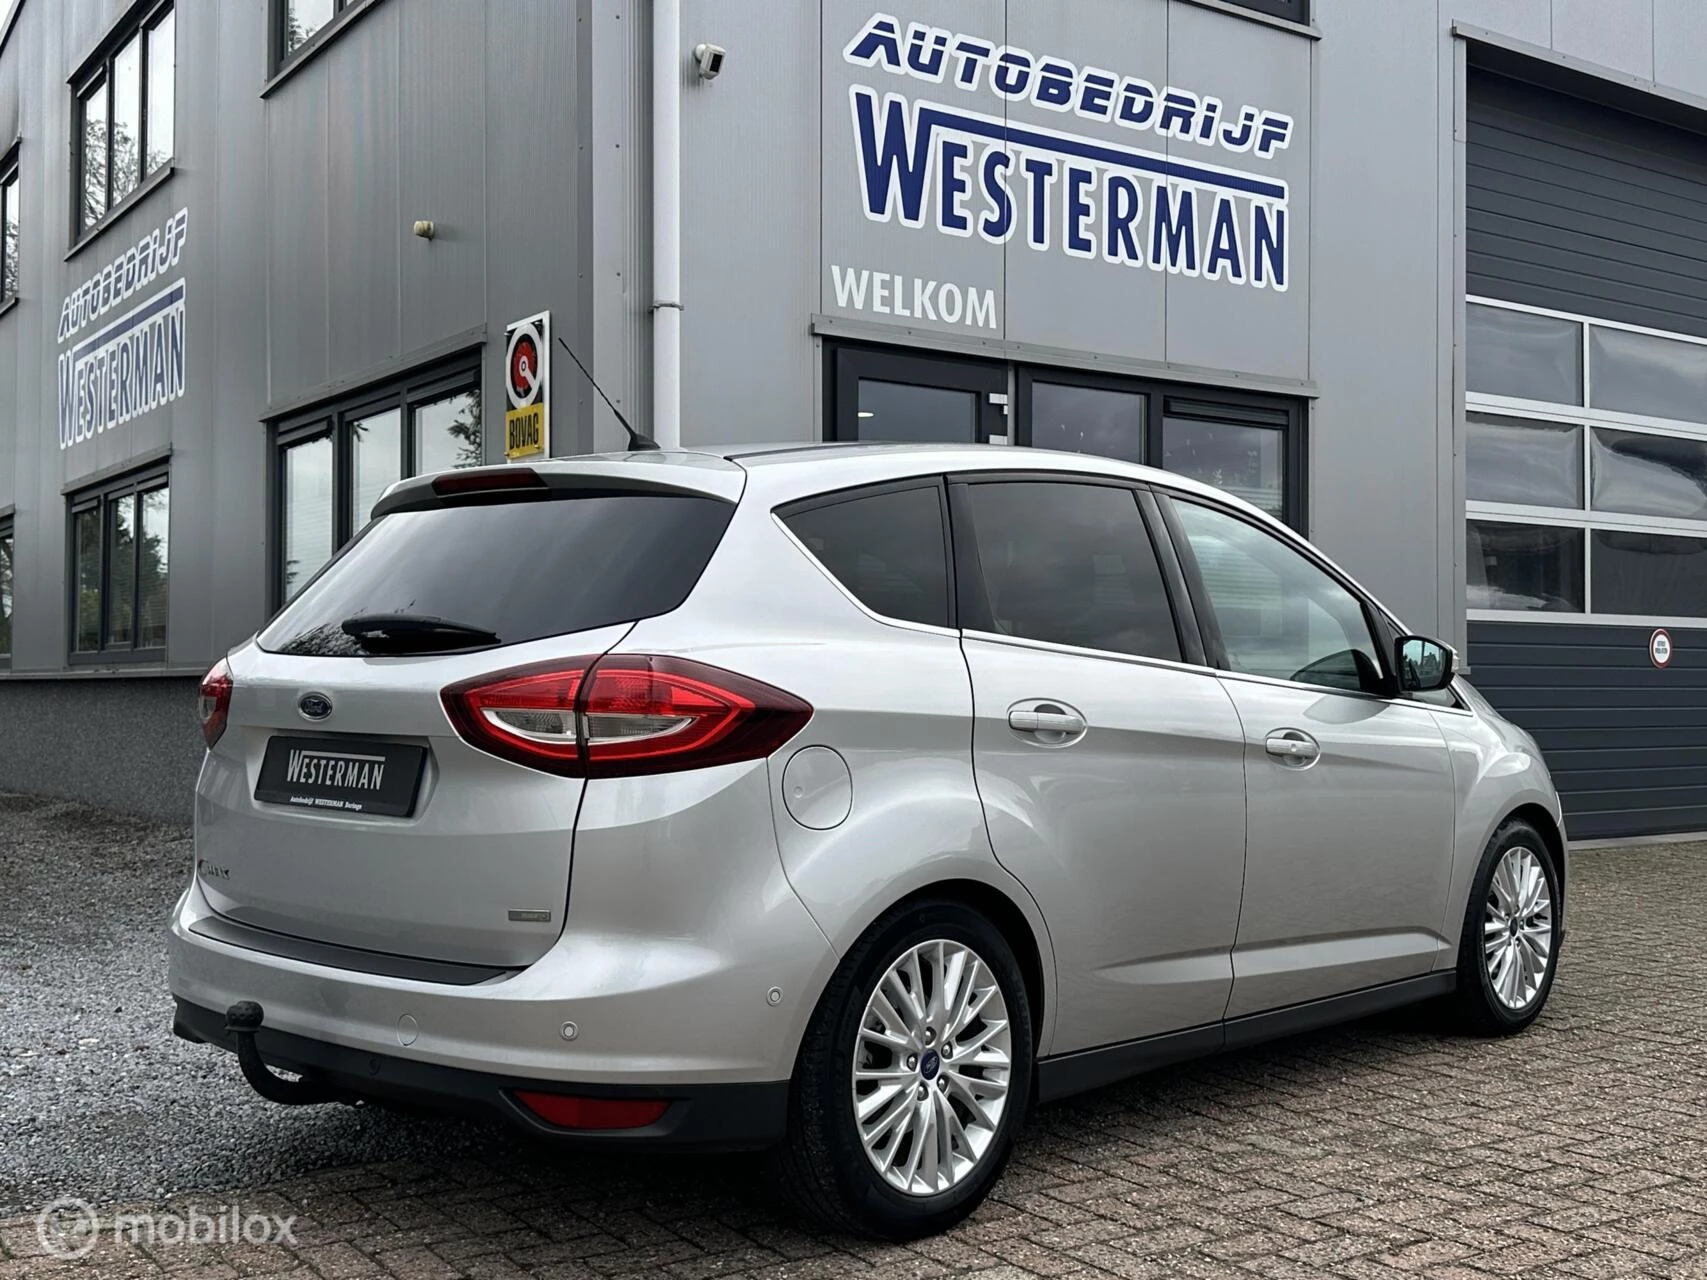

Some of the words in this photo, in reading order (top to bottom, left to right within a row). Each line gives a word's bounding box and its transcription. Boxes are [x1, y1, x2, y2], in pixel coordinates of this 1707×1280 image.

[845, 14, 1293, 159] AUTOBEDRIJF
[849, 84, 1290, 291] WESTERMAN
[58, 207, 188, 343] AUTOBEDRIJF
[831, 265, 997, 329] WELKOM
[58, 278, 186, 450] WESTERMAN
[509, 412, 539, 450] BOVAG
[286, 749, 386, 790] WESTERMAN
